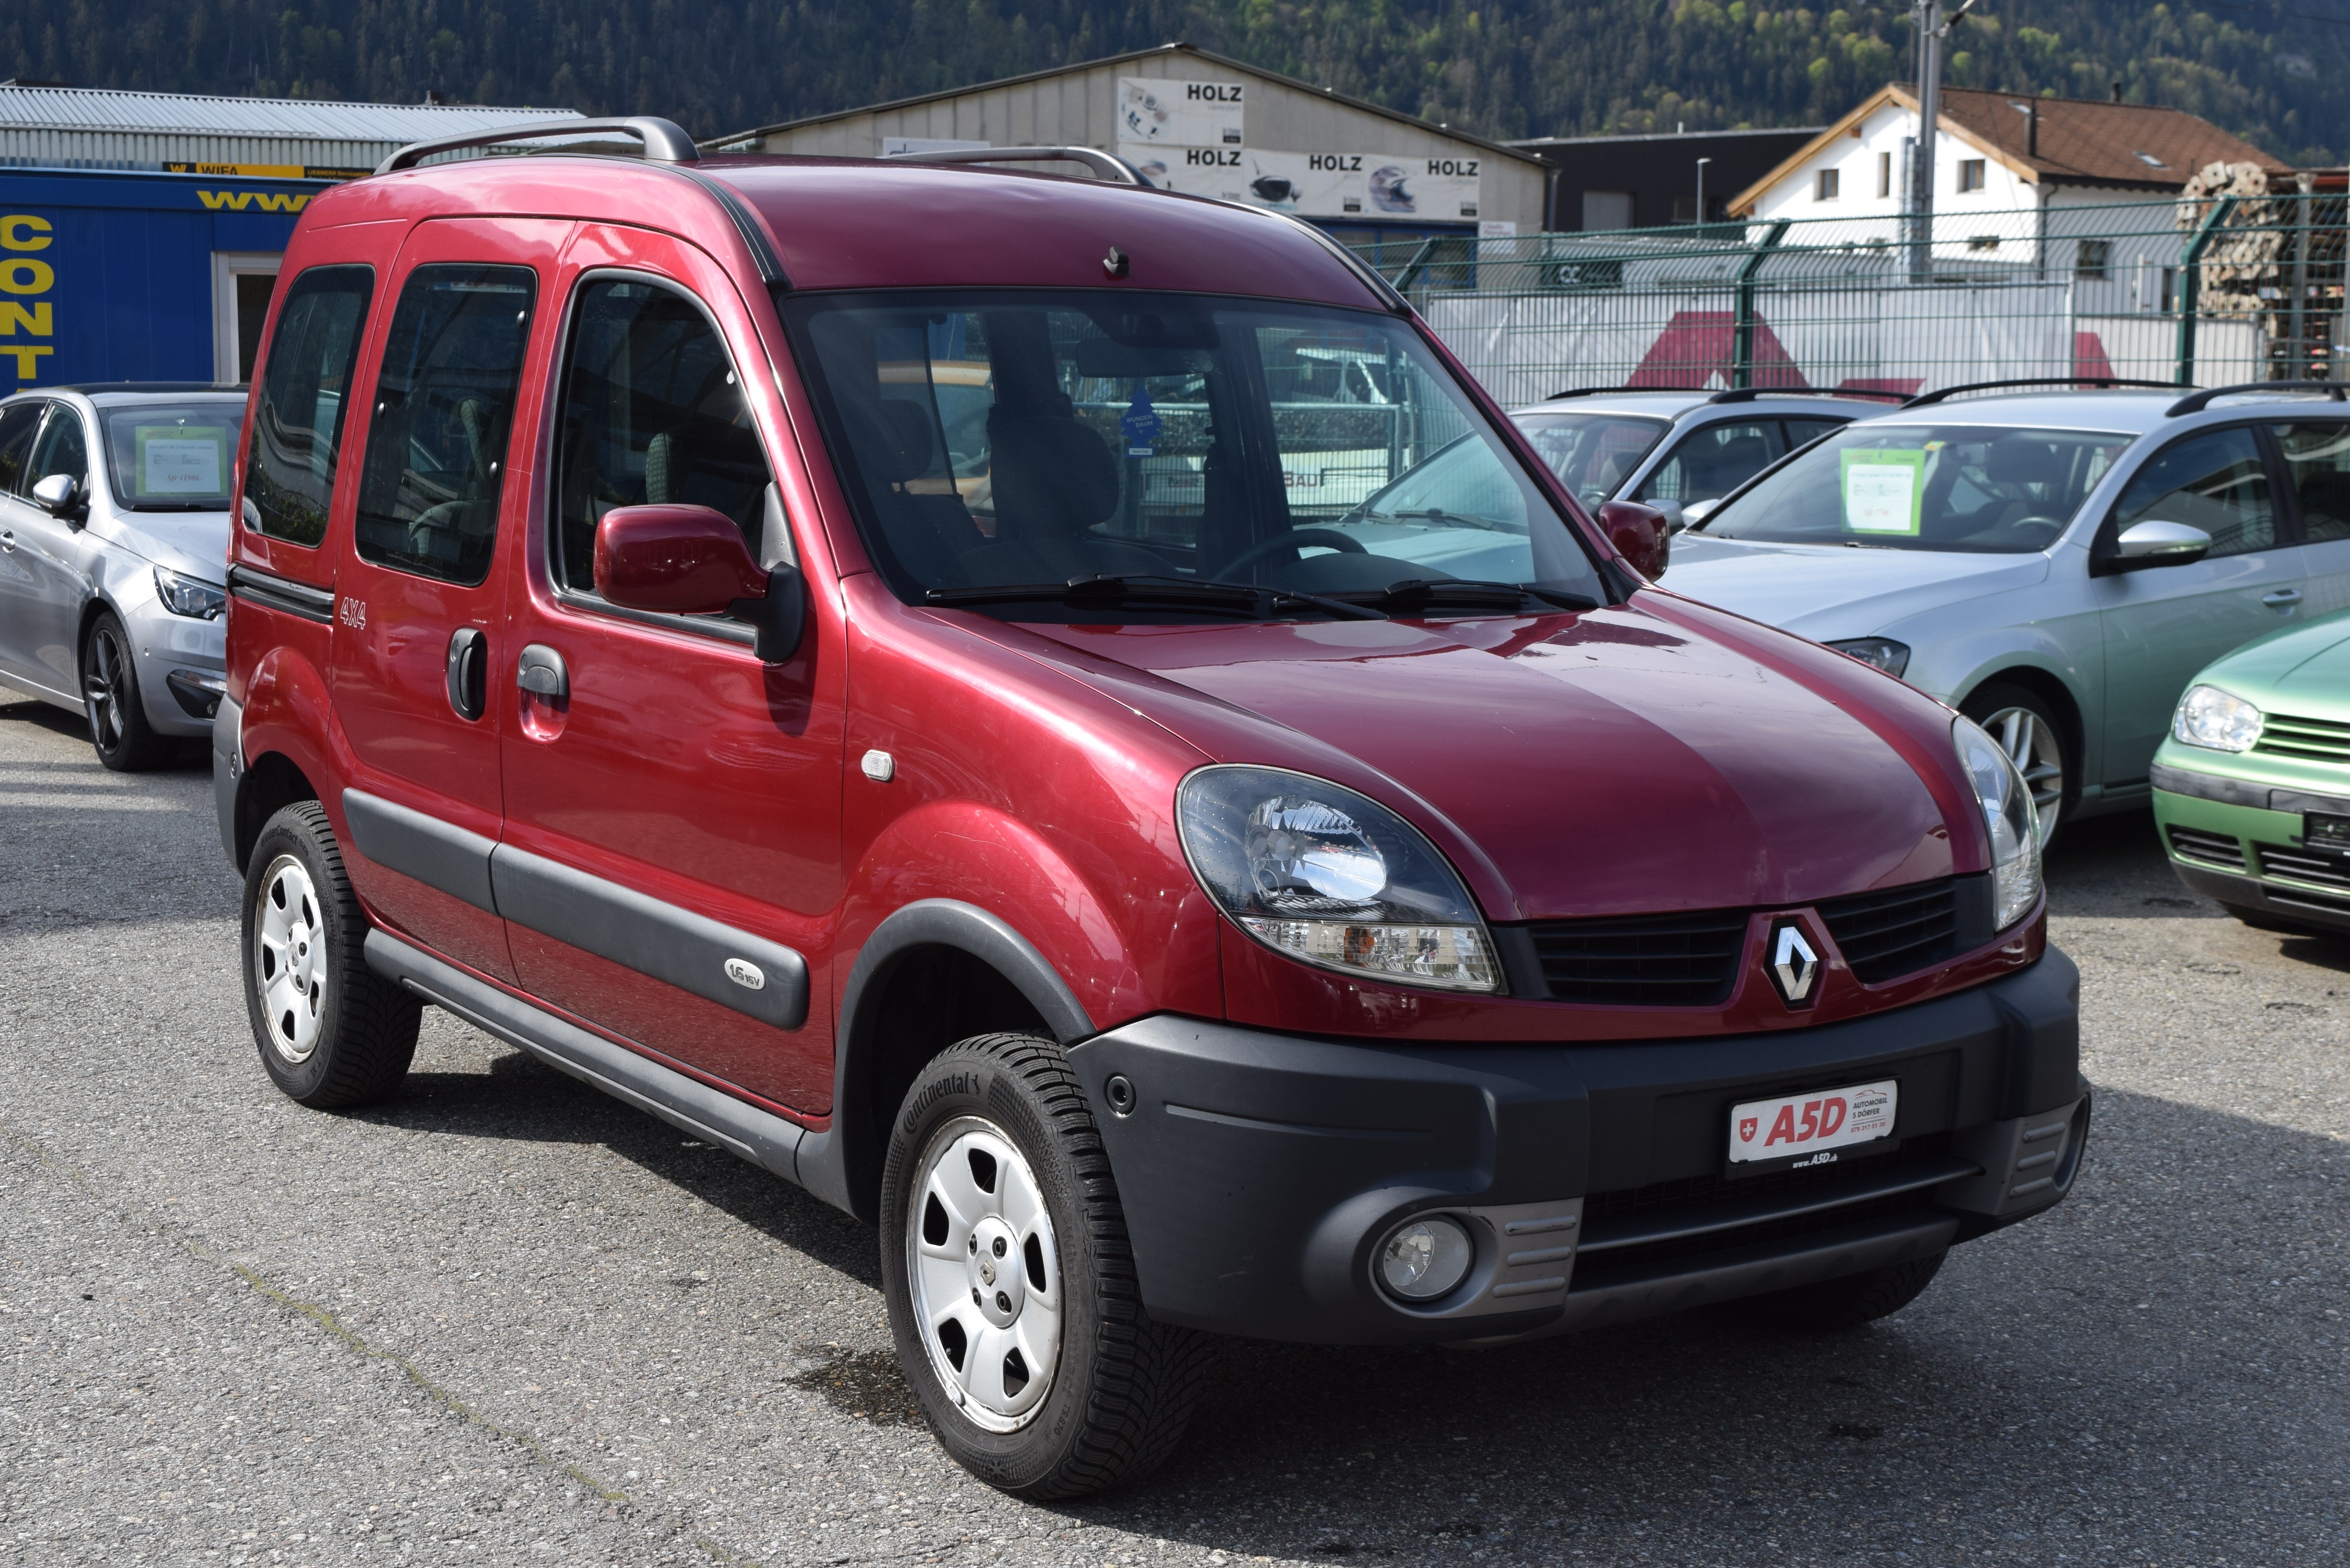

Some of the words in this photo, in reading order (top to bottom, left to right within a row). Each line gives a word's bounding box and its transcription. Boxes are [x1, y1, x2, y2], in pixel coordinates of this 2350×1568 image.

[1188, 85, 1242, 102] HOLZ
[1187, 149, 1241, 166] HOLZ
[1309, 155, 1362, 171] HOLZ
[1428, 160, 1478, 176] HOLZ
[1126, 414, 1154, 423] WUNDER-
[261, 824, 298, 847] WinterContact
[730, 964, 744, 981] 1.6
[903, 1071, 971, 1135] Continental
[1853, 1097, 1887, 1109] AUTOMOBIL
[1858, 1108, 1880, 1117] DÖRFER
[1764, 1097, 1847, 1147] A5D
[1793, 1152, 1837, 1168] www.A5D.ch
